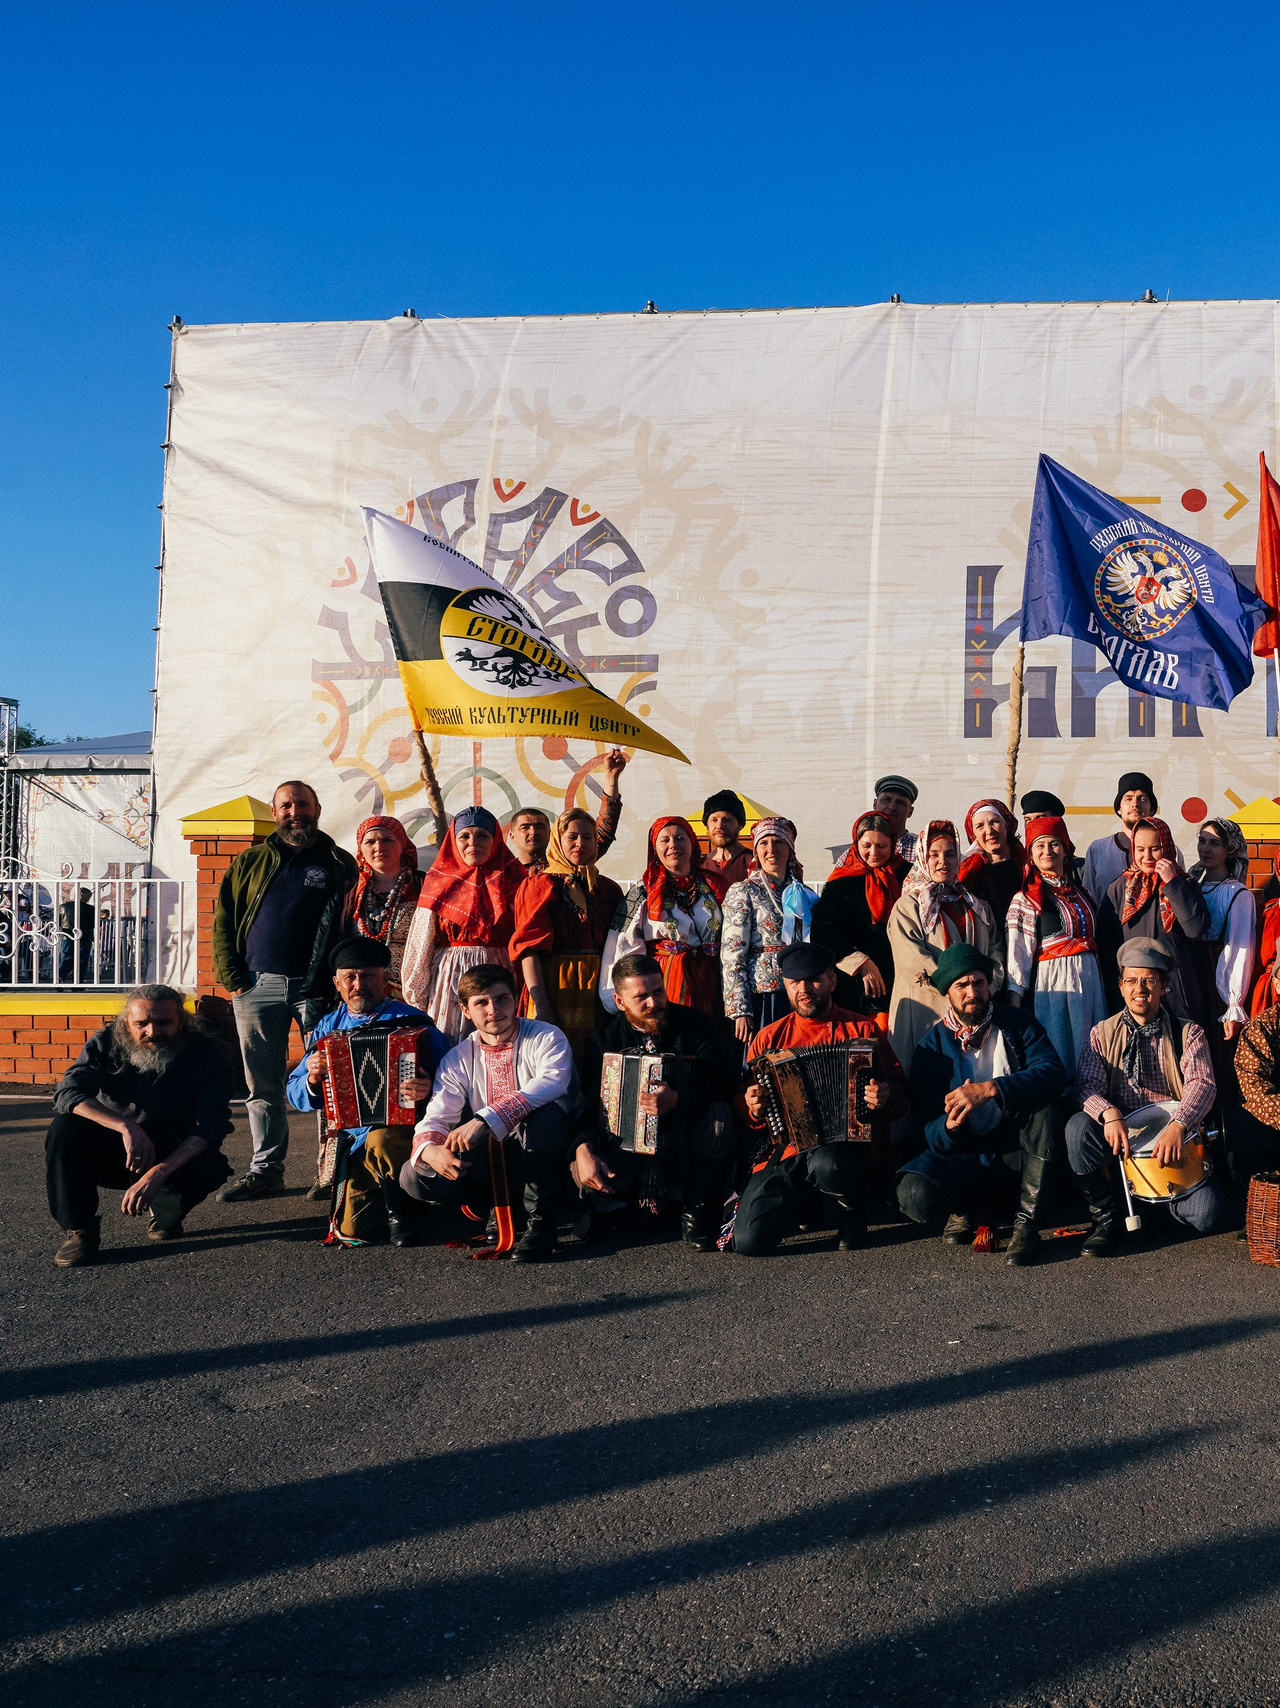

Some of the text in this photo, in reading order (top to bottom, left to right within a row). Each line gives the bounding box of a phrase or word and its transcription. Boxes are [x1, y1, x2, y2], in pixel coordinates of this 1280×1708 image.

[425, 706, 641, 738] РУССКИЙ КУЛЬТУРНЫЙ ЦЕНТР
